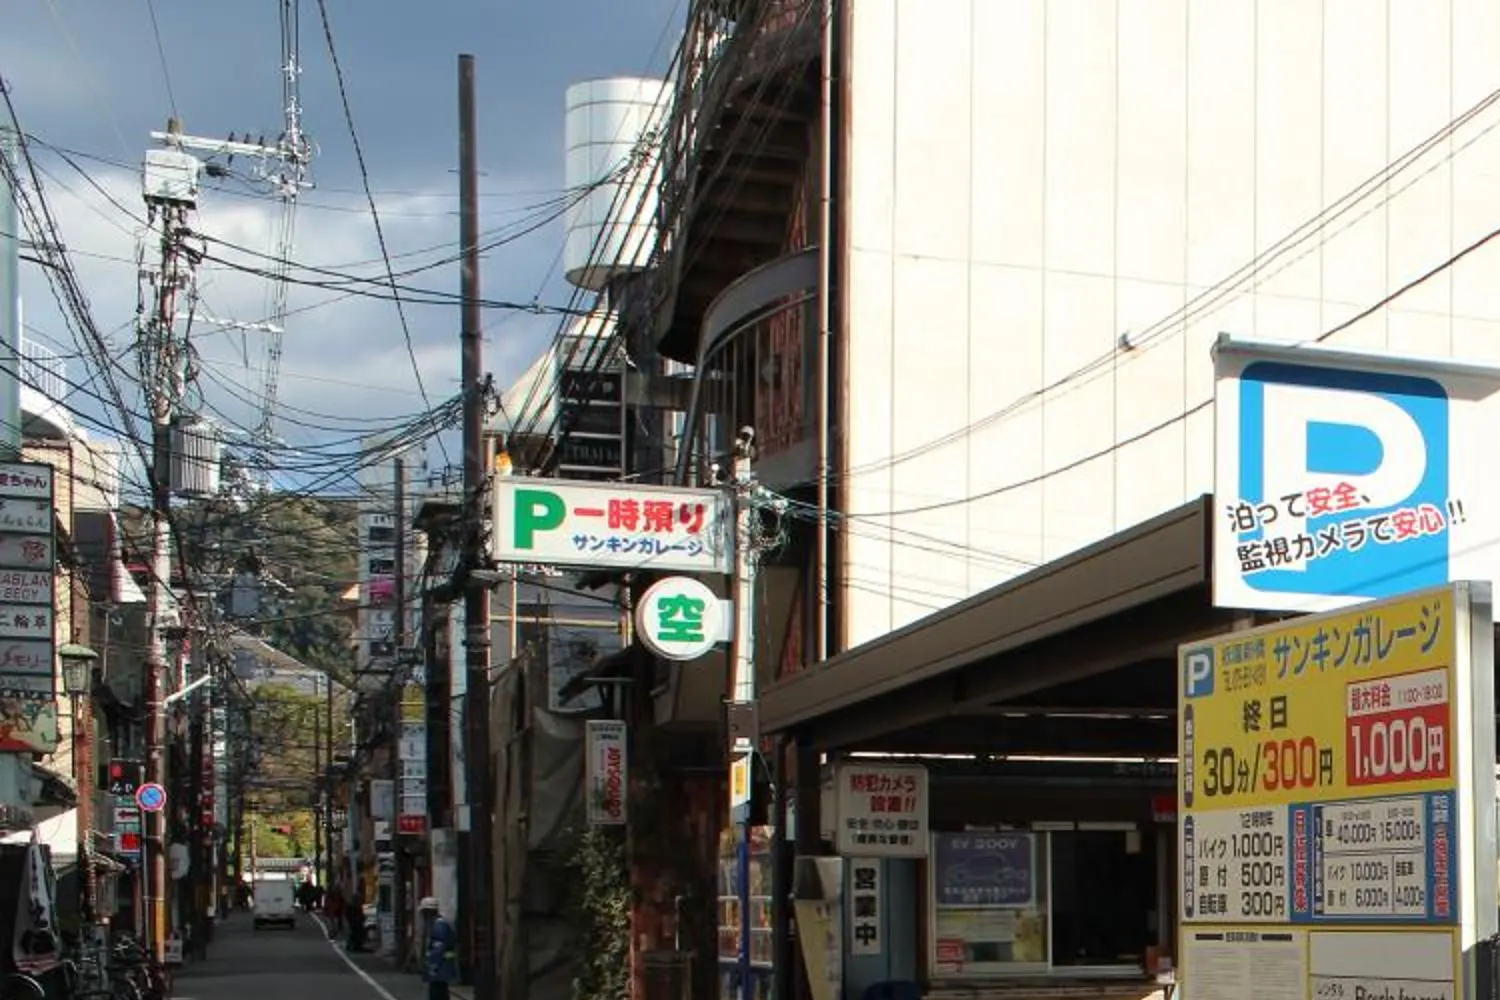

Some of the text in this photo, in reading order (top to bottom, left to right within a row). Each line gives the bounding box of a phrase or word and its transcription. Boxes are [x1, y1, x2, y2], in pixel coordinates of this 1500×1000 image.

[1263, 384, 1427, 572] P
[513, 489, 567, 549] P
[574, 499, 706, 533] 一時預り
[1227, 482, 1371, 532] 泊って安全、
[573, 534, 703, 557] サンキンガレージ
[657, 594, 705, 643] 空
[1273, 602, 1441, 679] サンキンガレージ
[1187, 653, 1210, 695] P
[1243, 696, 1287, 733] 終日
[1203, 736, 1333, 797] 30分/300円
[1351, 715, 1445, 778] 1,000円
[1199, 832, 1285, 859] バイク 1,000円
[1241, 861, 1285, 887] 500円
[1241, 890, 1285, 916] 300円
